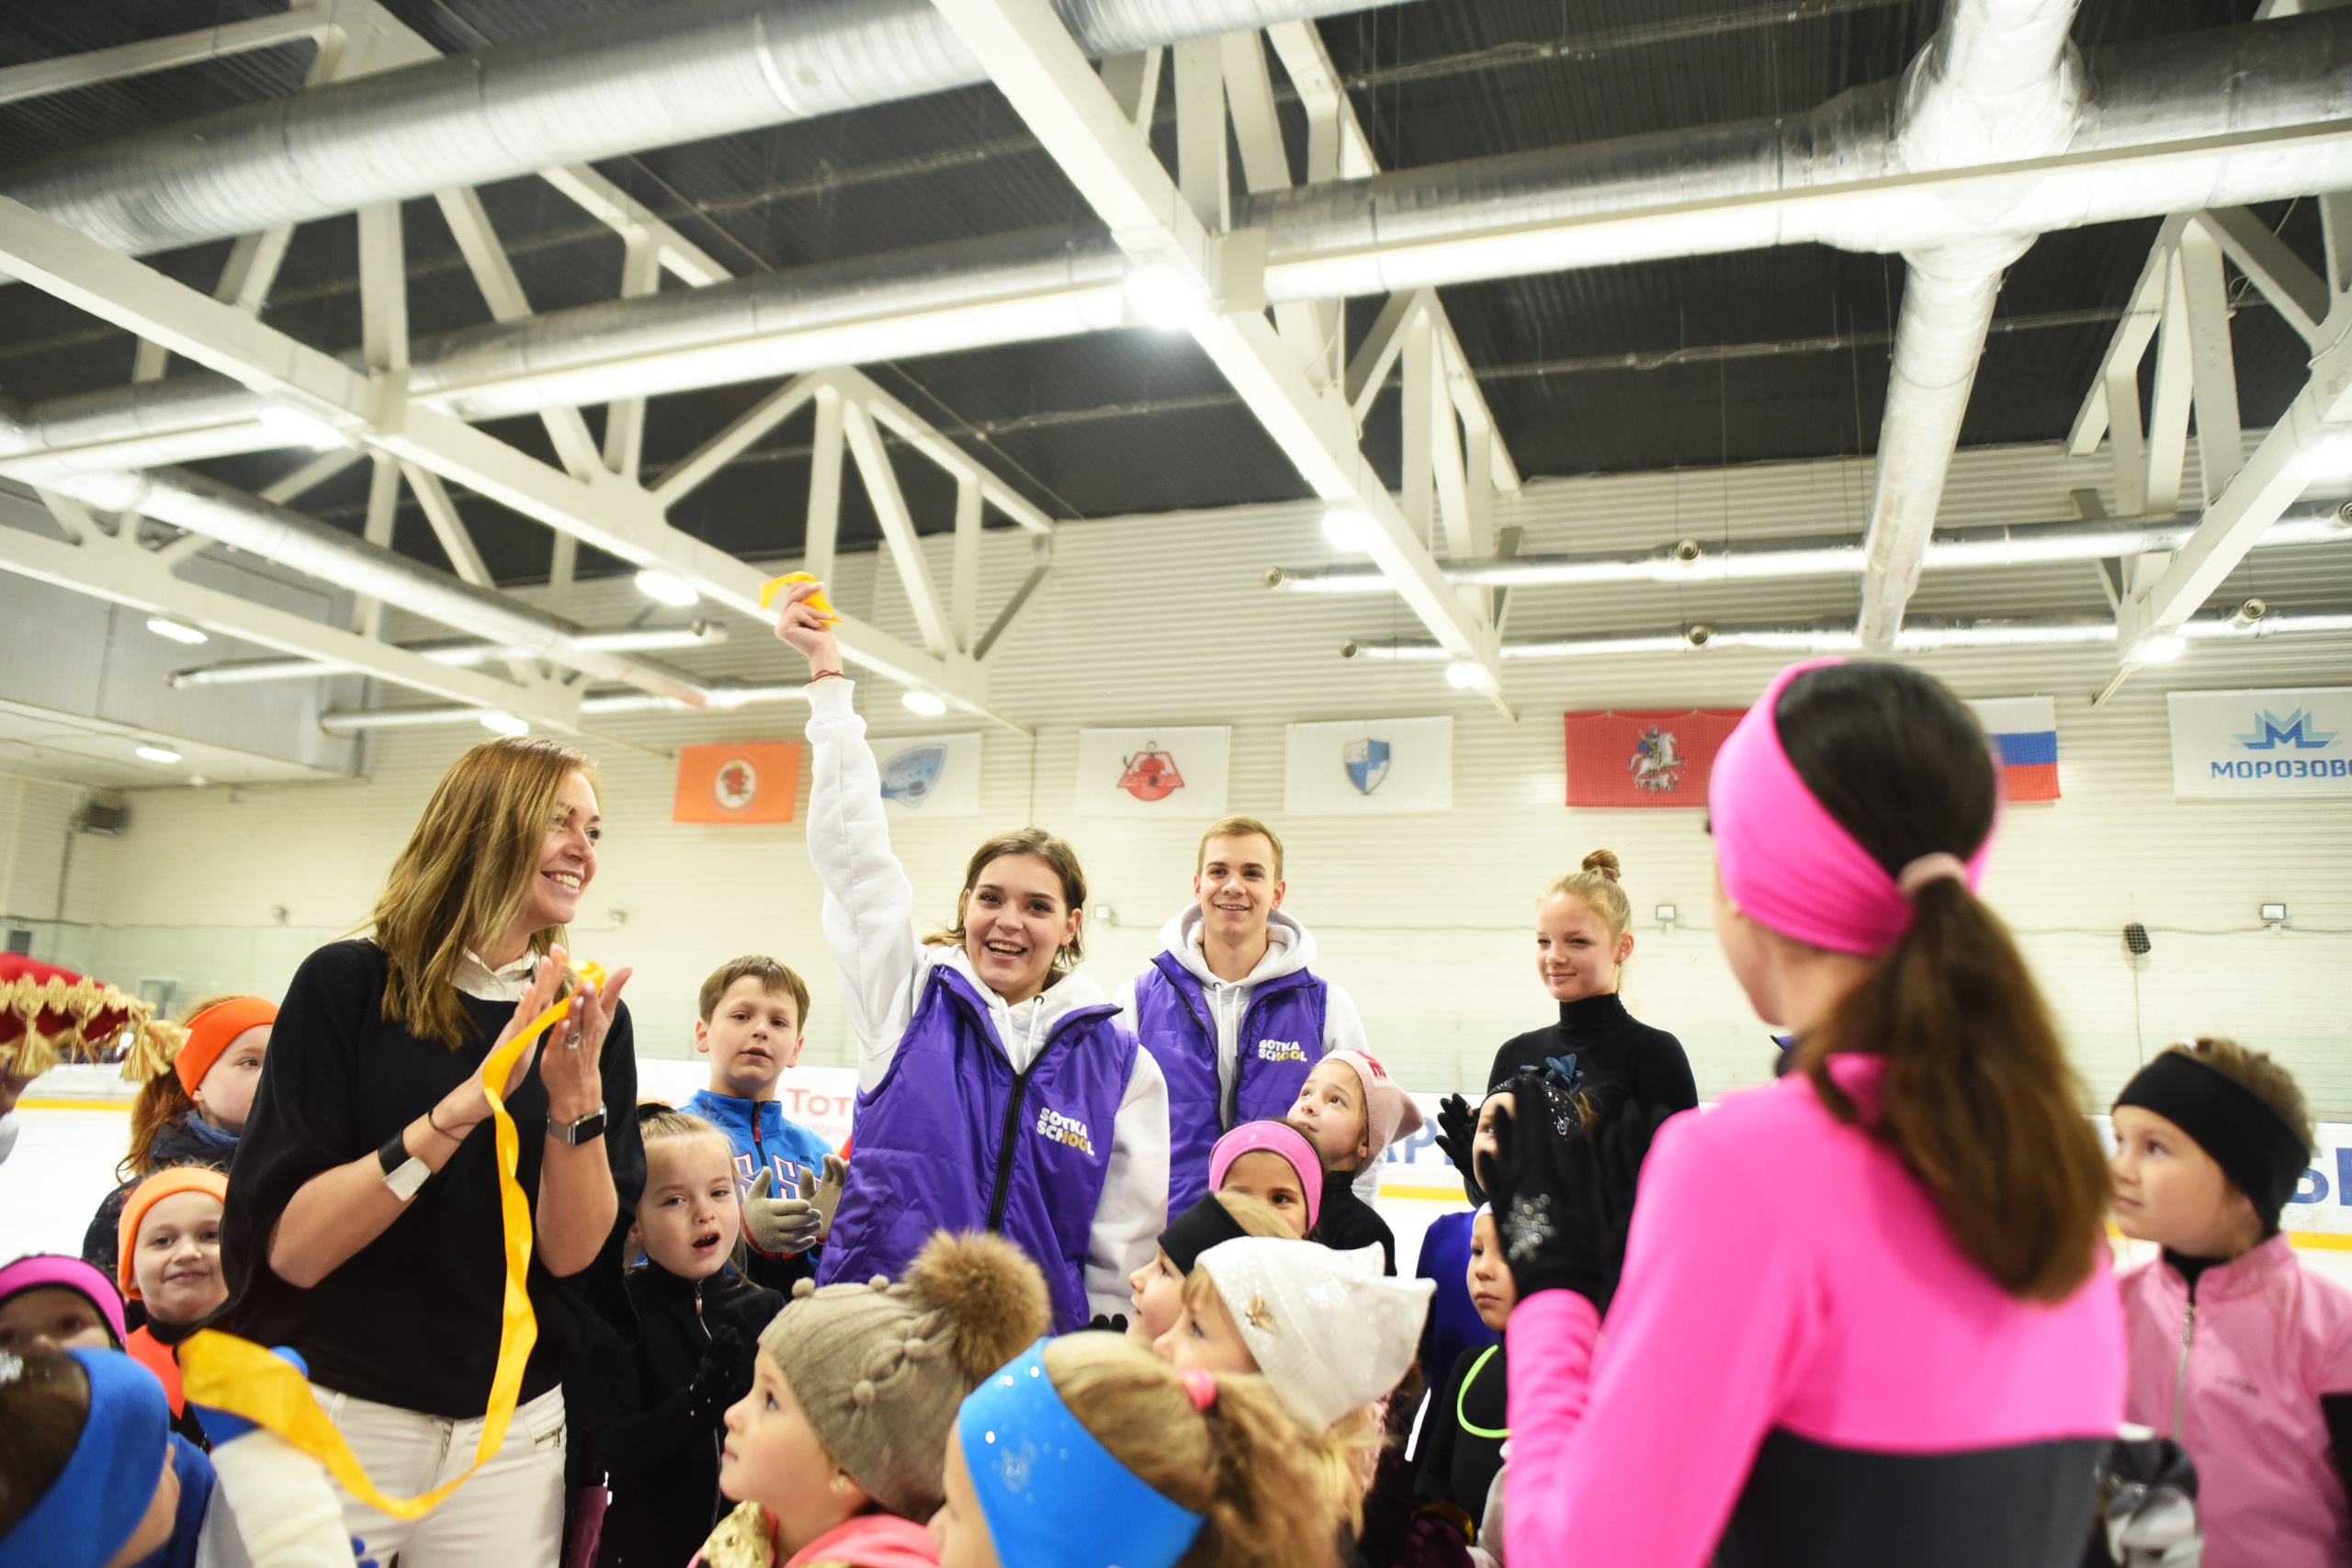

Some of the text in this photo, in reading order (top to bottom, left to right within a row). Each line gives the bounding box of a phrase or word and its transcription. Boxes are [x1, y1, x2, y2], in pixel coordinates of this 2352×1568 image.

[1258, 1048, 1307, 1063] SCHOOL
[1259, 1039, 1300, 1052] SOTKA
[1039, 1107, 1088, 1139] SOTKA
[1036, 1120, 1095, 1156] SCHOOL
